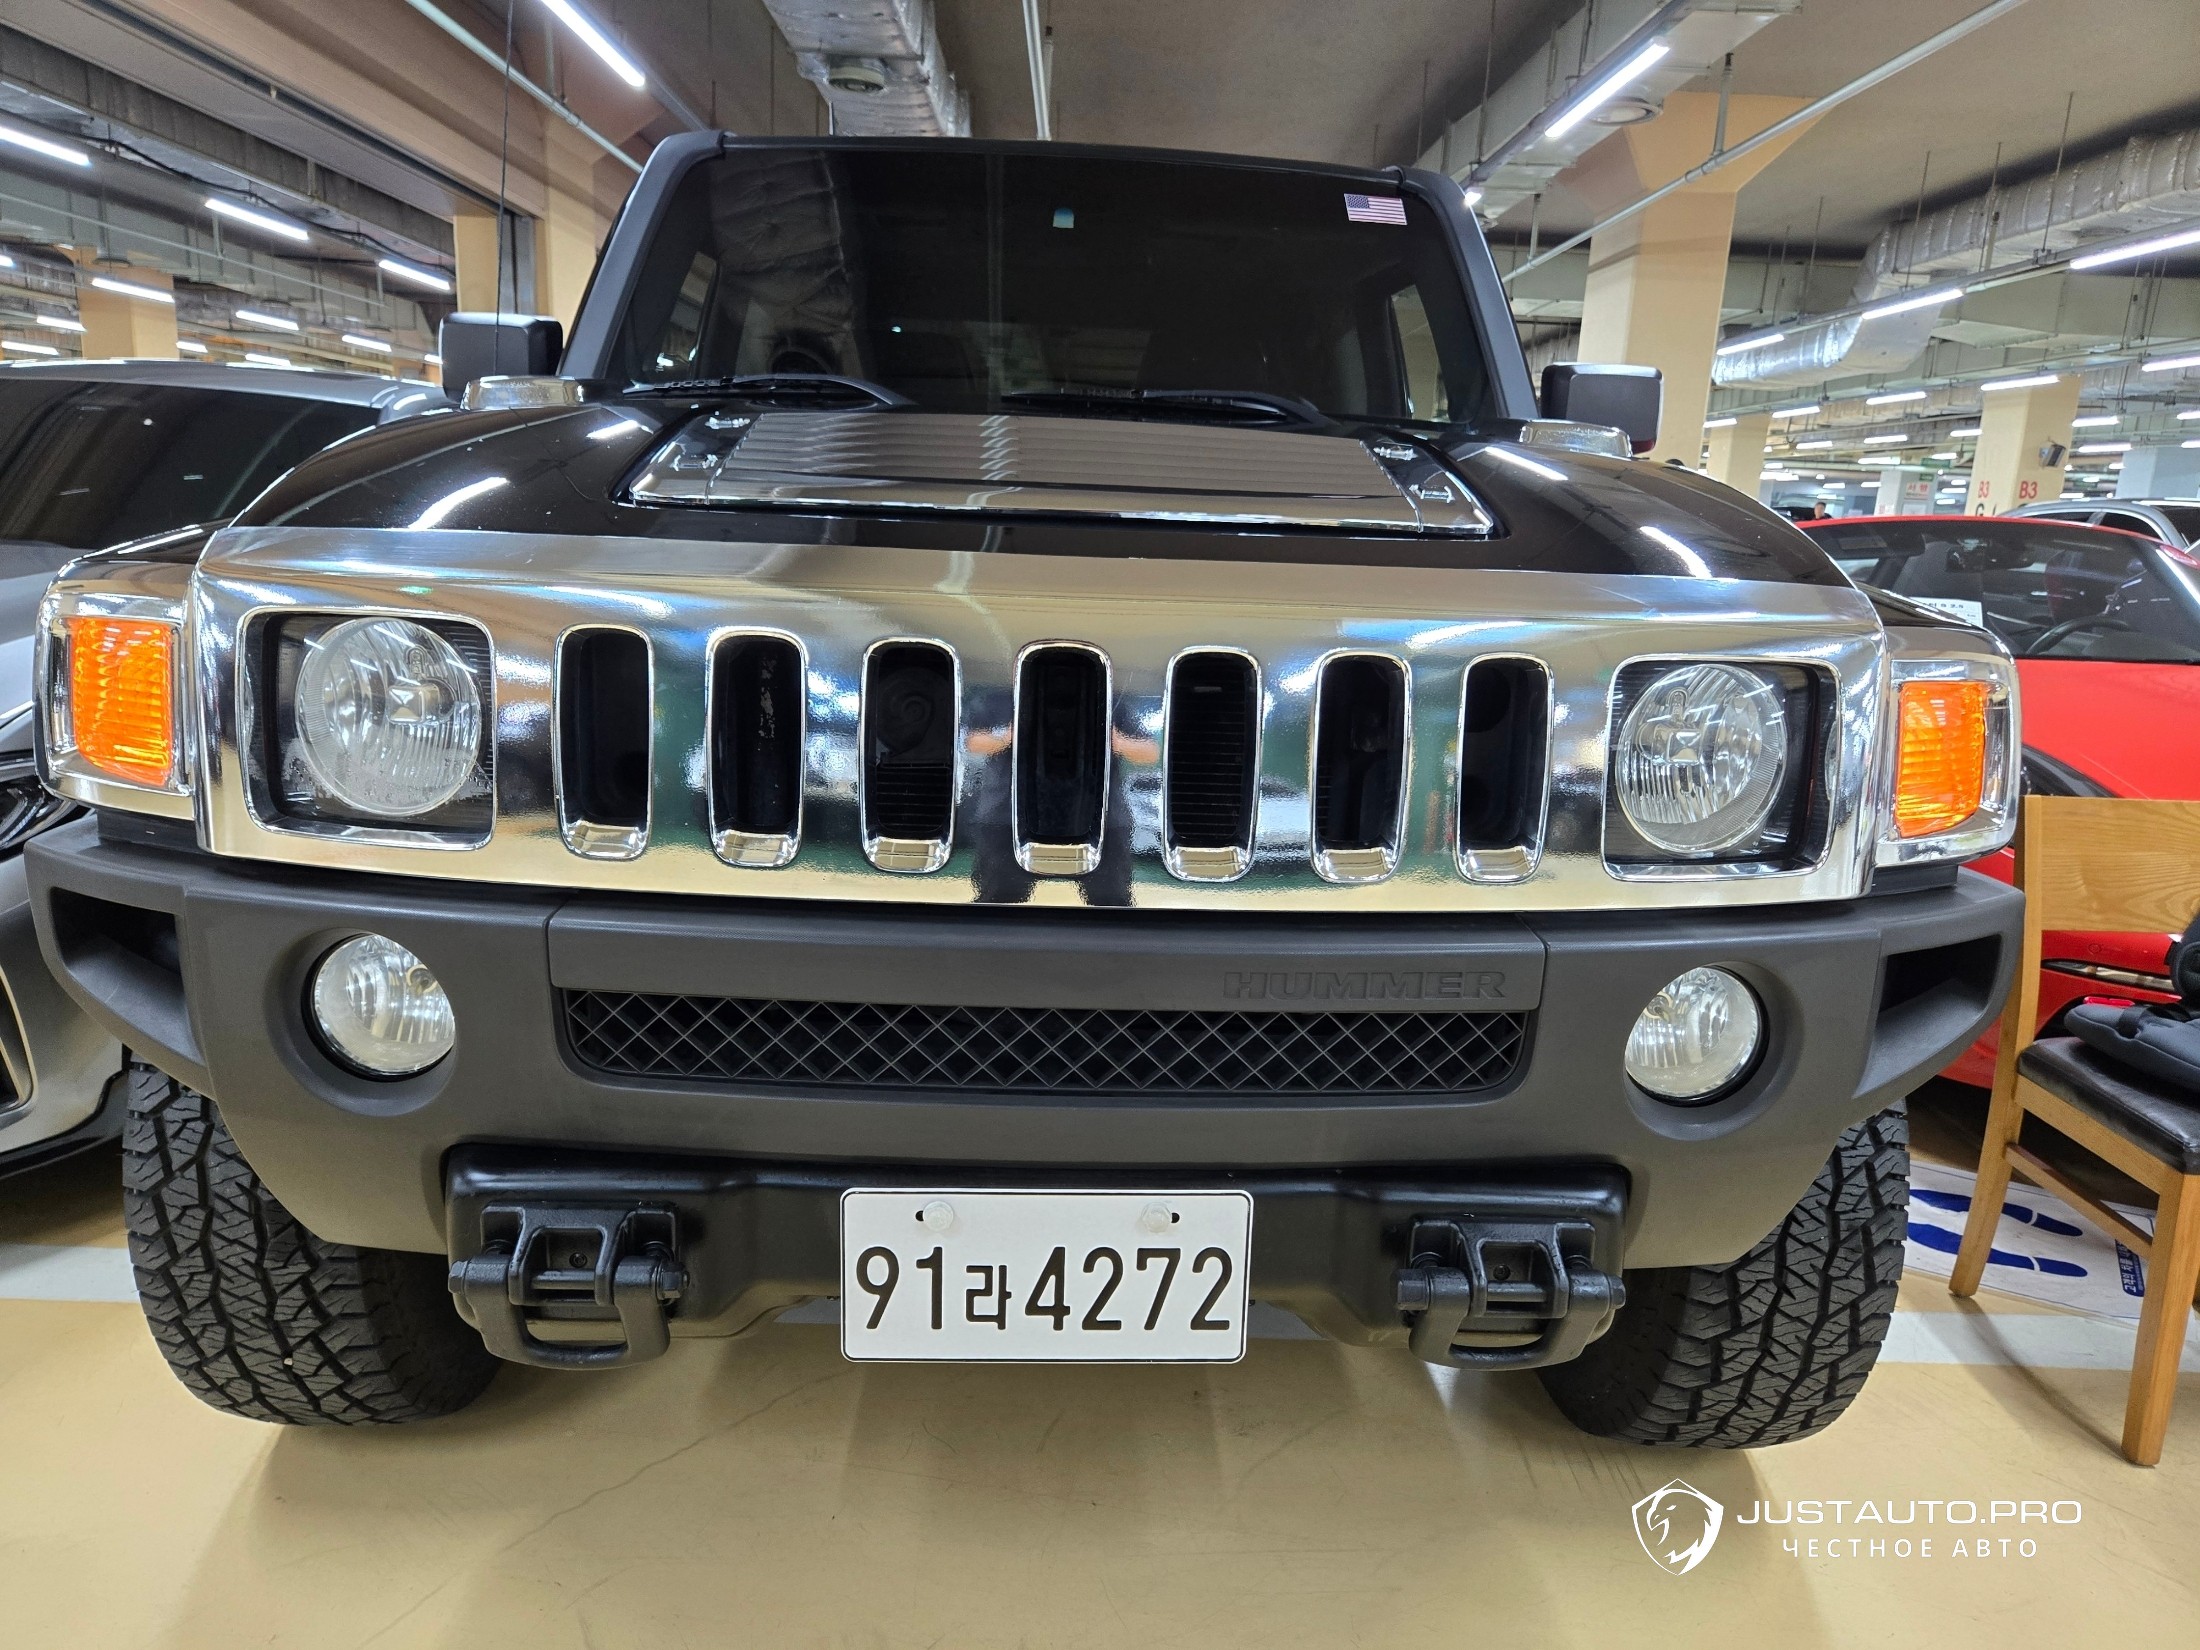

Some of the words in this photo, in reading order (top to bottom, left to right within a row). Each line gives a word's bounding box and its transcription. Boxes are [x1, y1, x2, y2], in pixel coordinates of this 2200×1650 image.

[1977, 481, 1990, 498] B3
[2018, 480, 2038, 499] B3
[1223, 971, 1506, 999] HUMMER
[856, 1246, 1233, 1331] 91라4272
